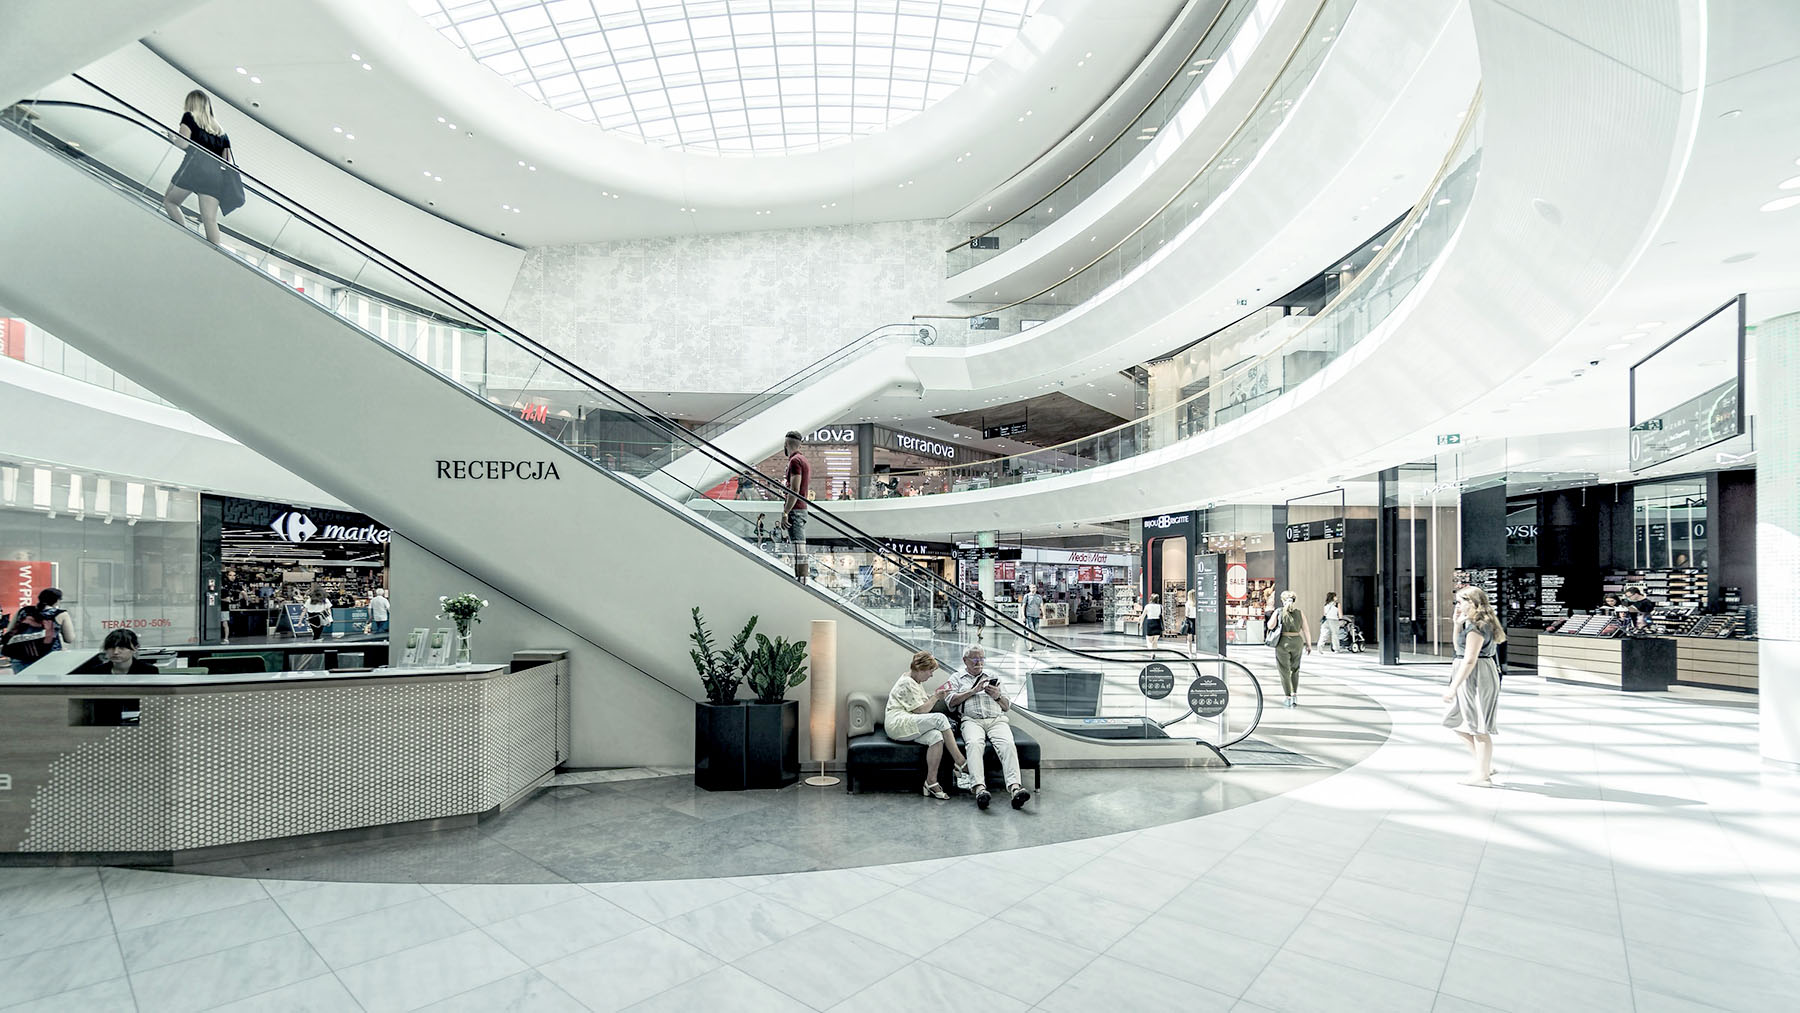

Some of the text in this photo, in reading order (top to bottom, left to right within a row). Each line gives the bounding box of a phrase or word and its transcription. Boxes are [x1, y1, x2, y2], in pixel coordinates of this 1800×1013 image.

[520, 402, 549, 424] H&M
[802, 428, 855, 442] nova
[435, 460, 560, 480] RECEPCJA
[1229, 578, 1245, 586] SALE
[101, 618, 171, 629] TERAZ DO -50%
